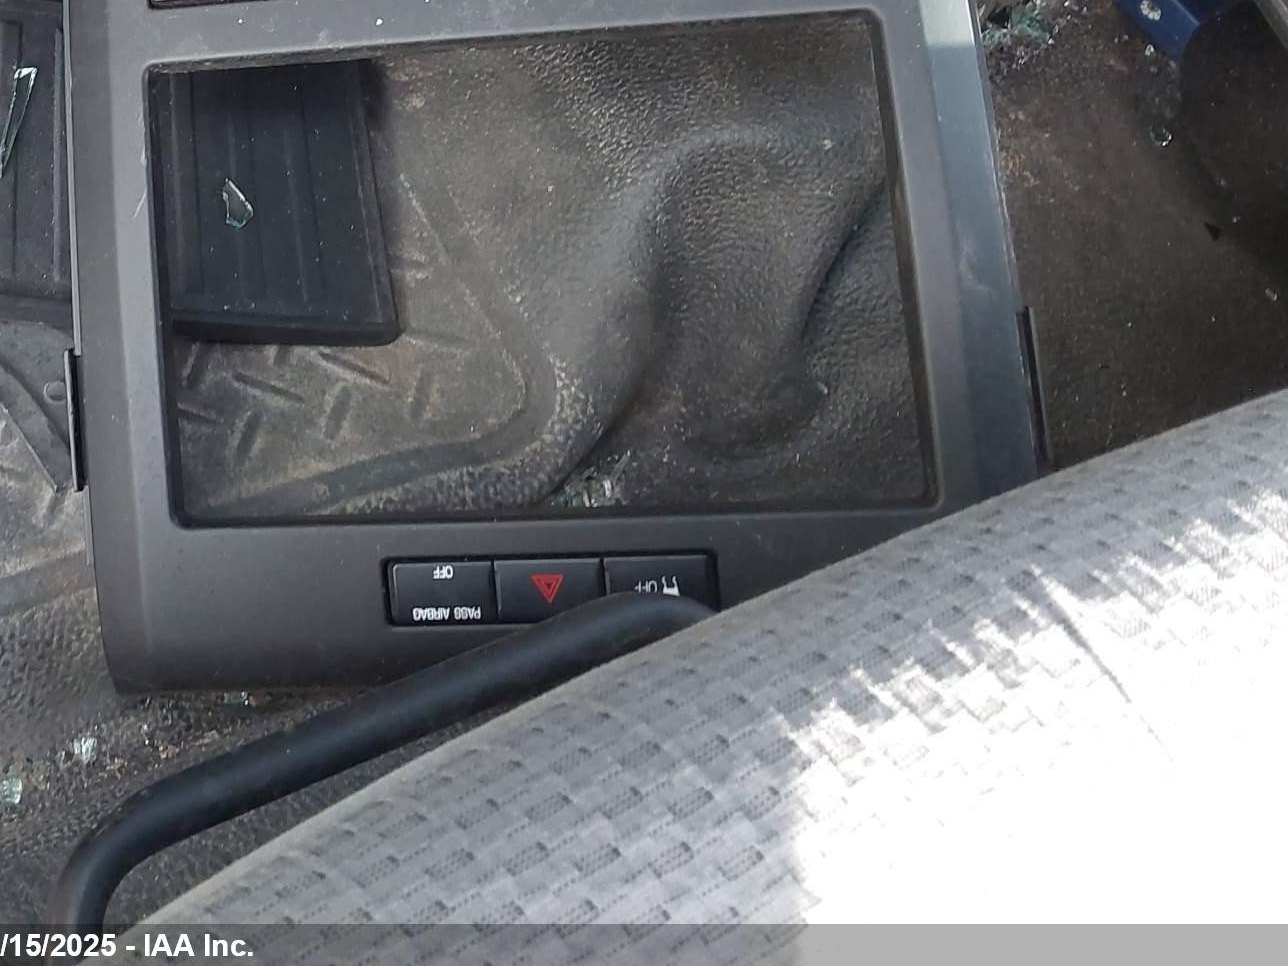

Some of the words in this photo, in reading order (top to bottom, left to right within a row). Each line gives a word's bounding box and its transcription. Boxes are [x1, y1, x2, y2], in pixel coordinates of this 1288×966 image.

[433, 565, 454, 579] OFF
[413, 607, 450, 621] AIRBAG
[454, 607, 481, 620] PASS
